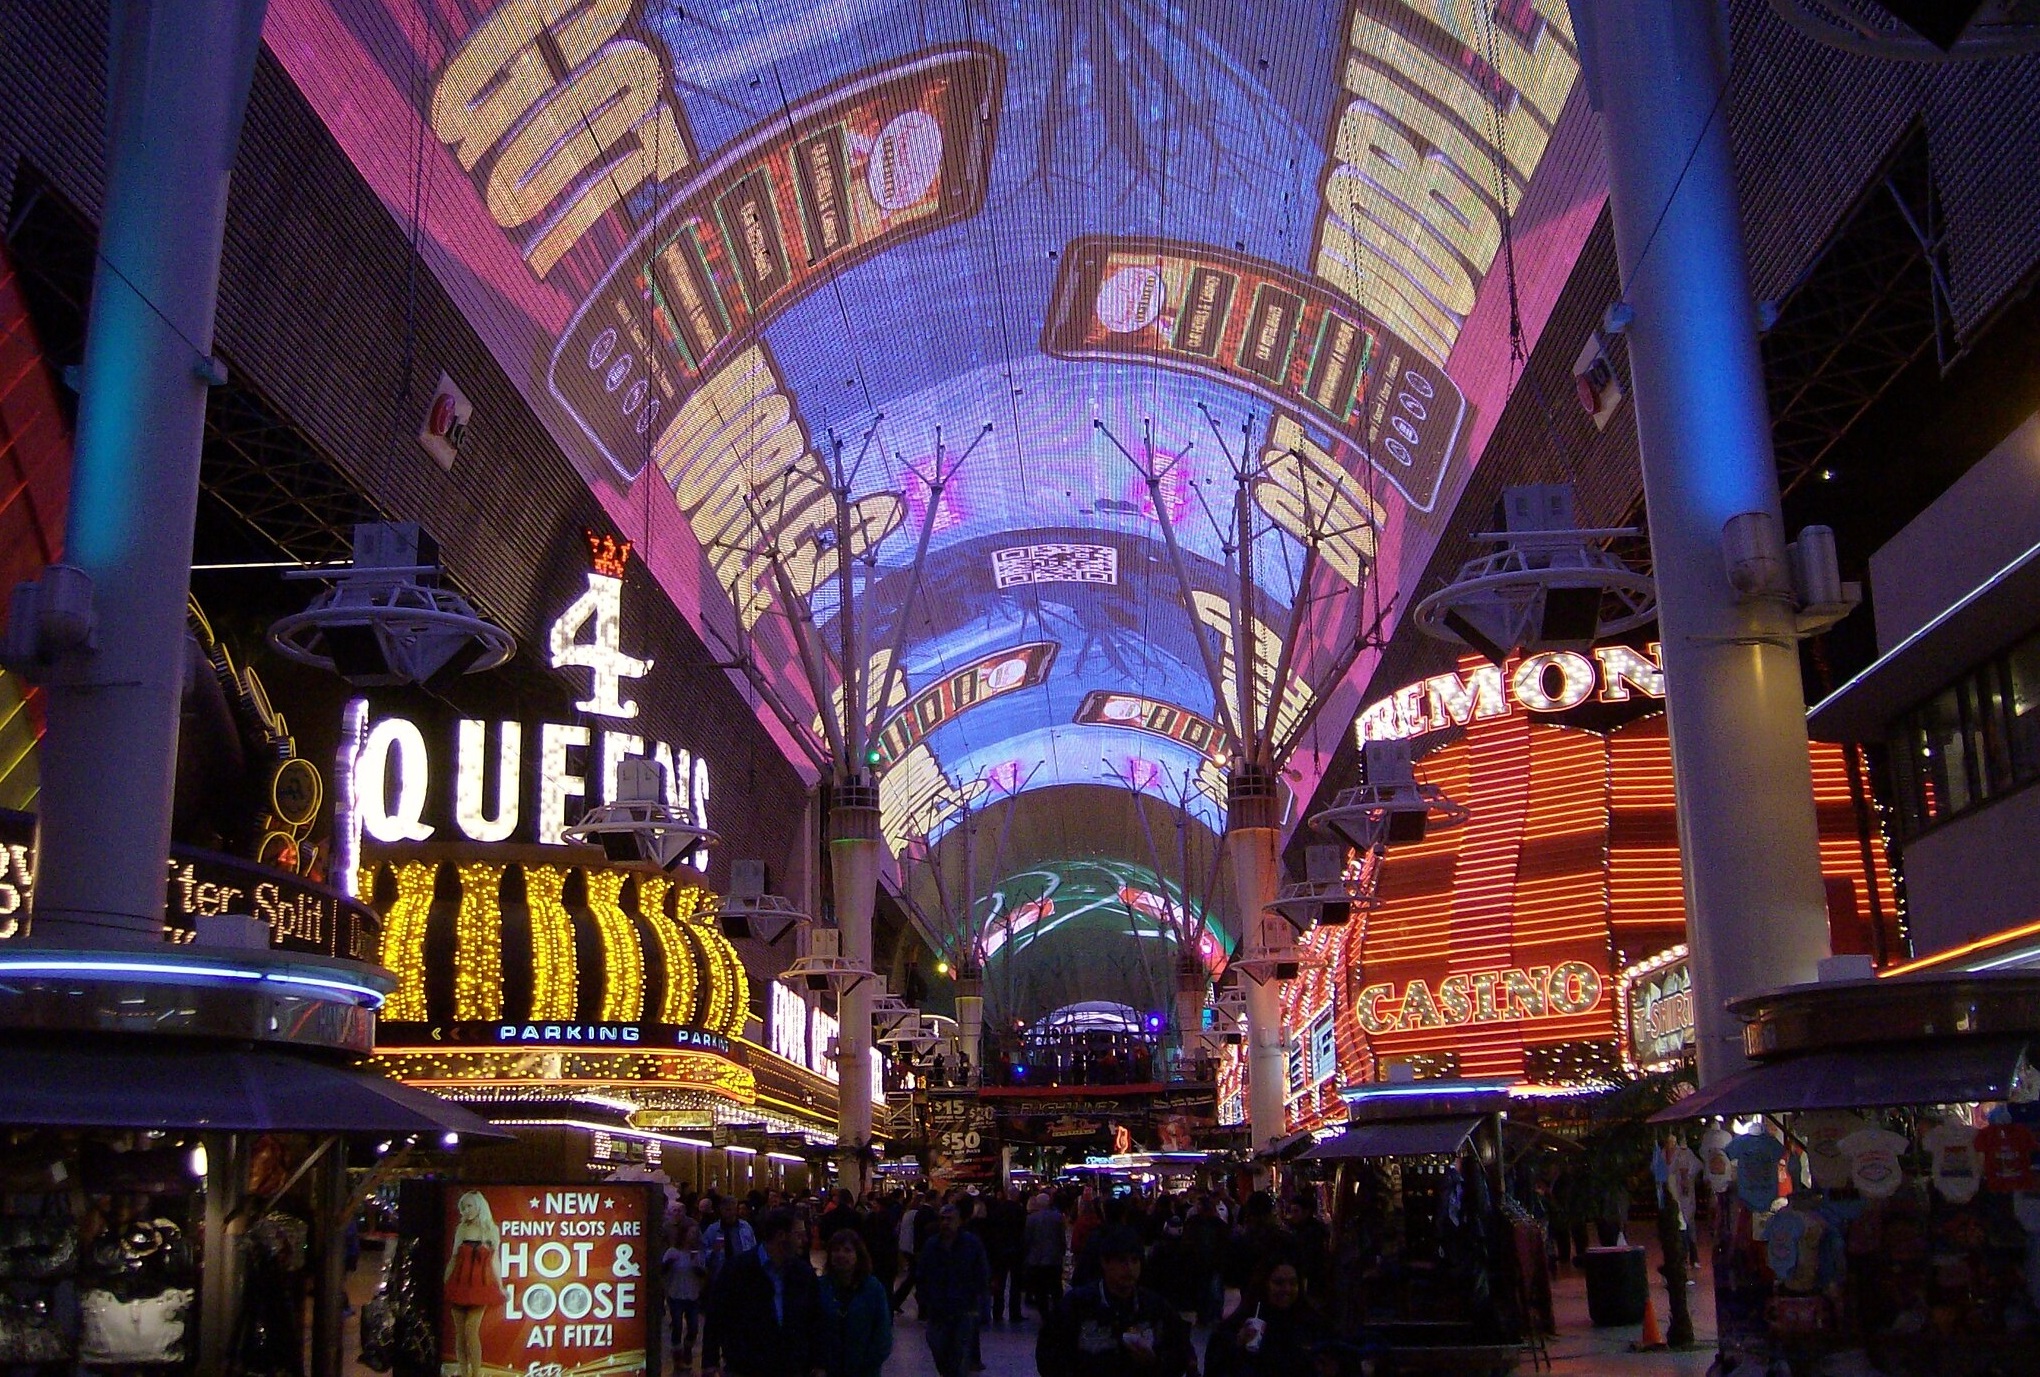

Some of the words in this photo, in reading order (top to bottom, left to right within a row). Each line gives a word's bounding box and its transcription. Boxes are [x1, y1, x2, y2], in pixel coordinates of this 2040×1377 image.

[550, 572, 655, 719] 4
[165, 859, 245, 917] ter
[252, 882, 324, 944] Split
[1356, 960, 1604, 1035] CASINO
[500, 1023, 641, 1043] PARKING
[678, 1029, 730, 1053] PARKING
[934, 1099, 965, 1115] $15
[941, 1131, 981, 1150] $50
[545, 1192, 600, 1214] NEW
[501, 1221, 555, 1236] PENNY
[560, 1221, 605, 1237] SLOTS
[610, 1221, 641, 1236] ARE
[501, 1241, 594, 1279] HOT
[612, 1243, 642, 1278] &
[505, 1282, 637, 1321] LOOSE
[526, 1325, 556, 1349] AT
[563, 1324, 614, 1347] FITZ!
